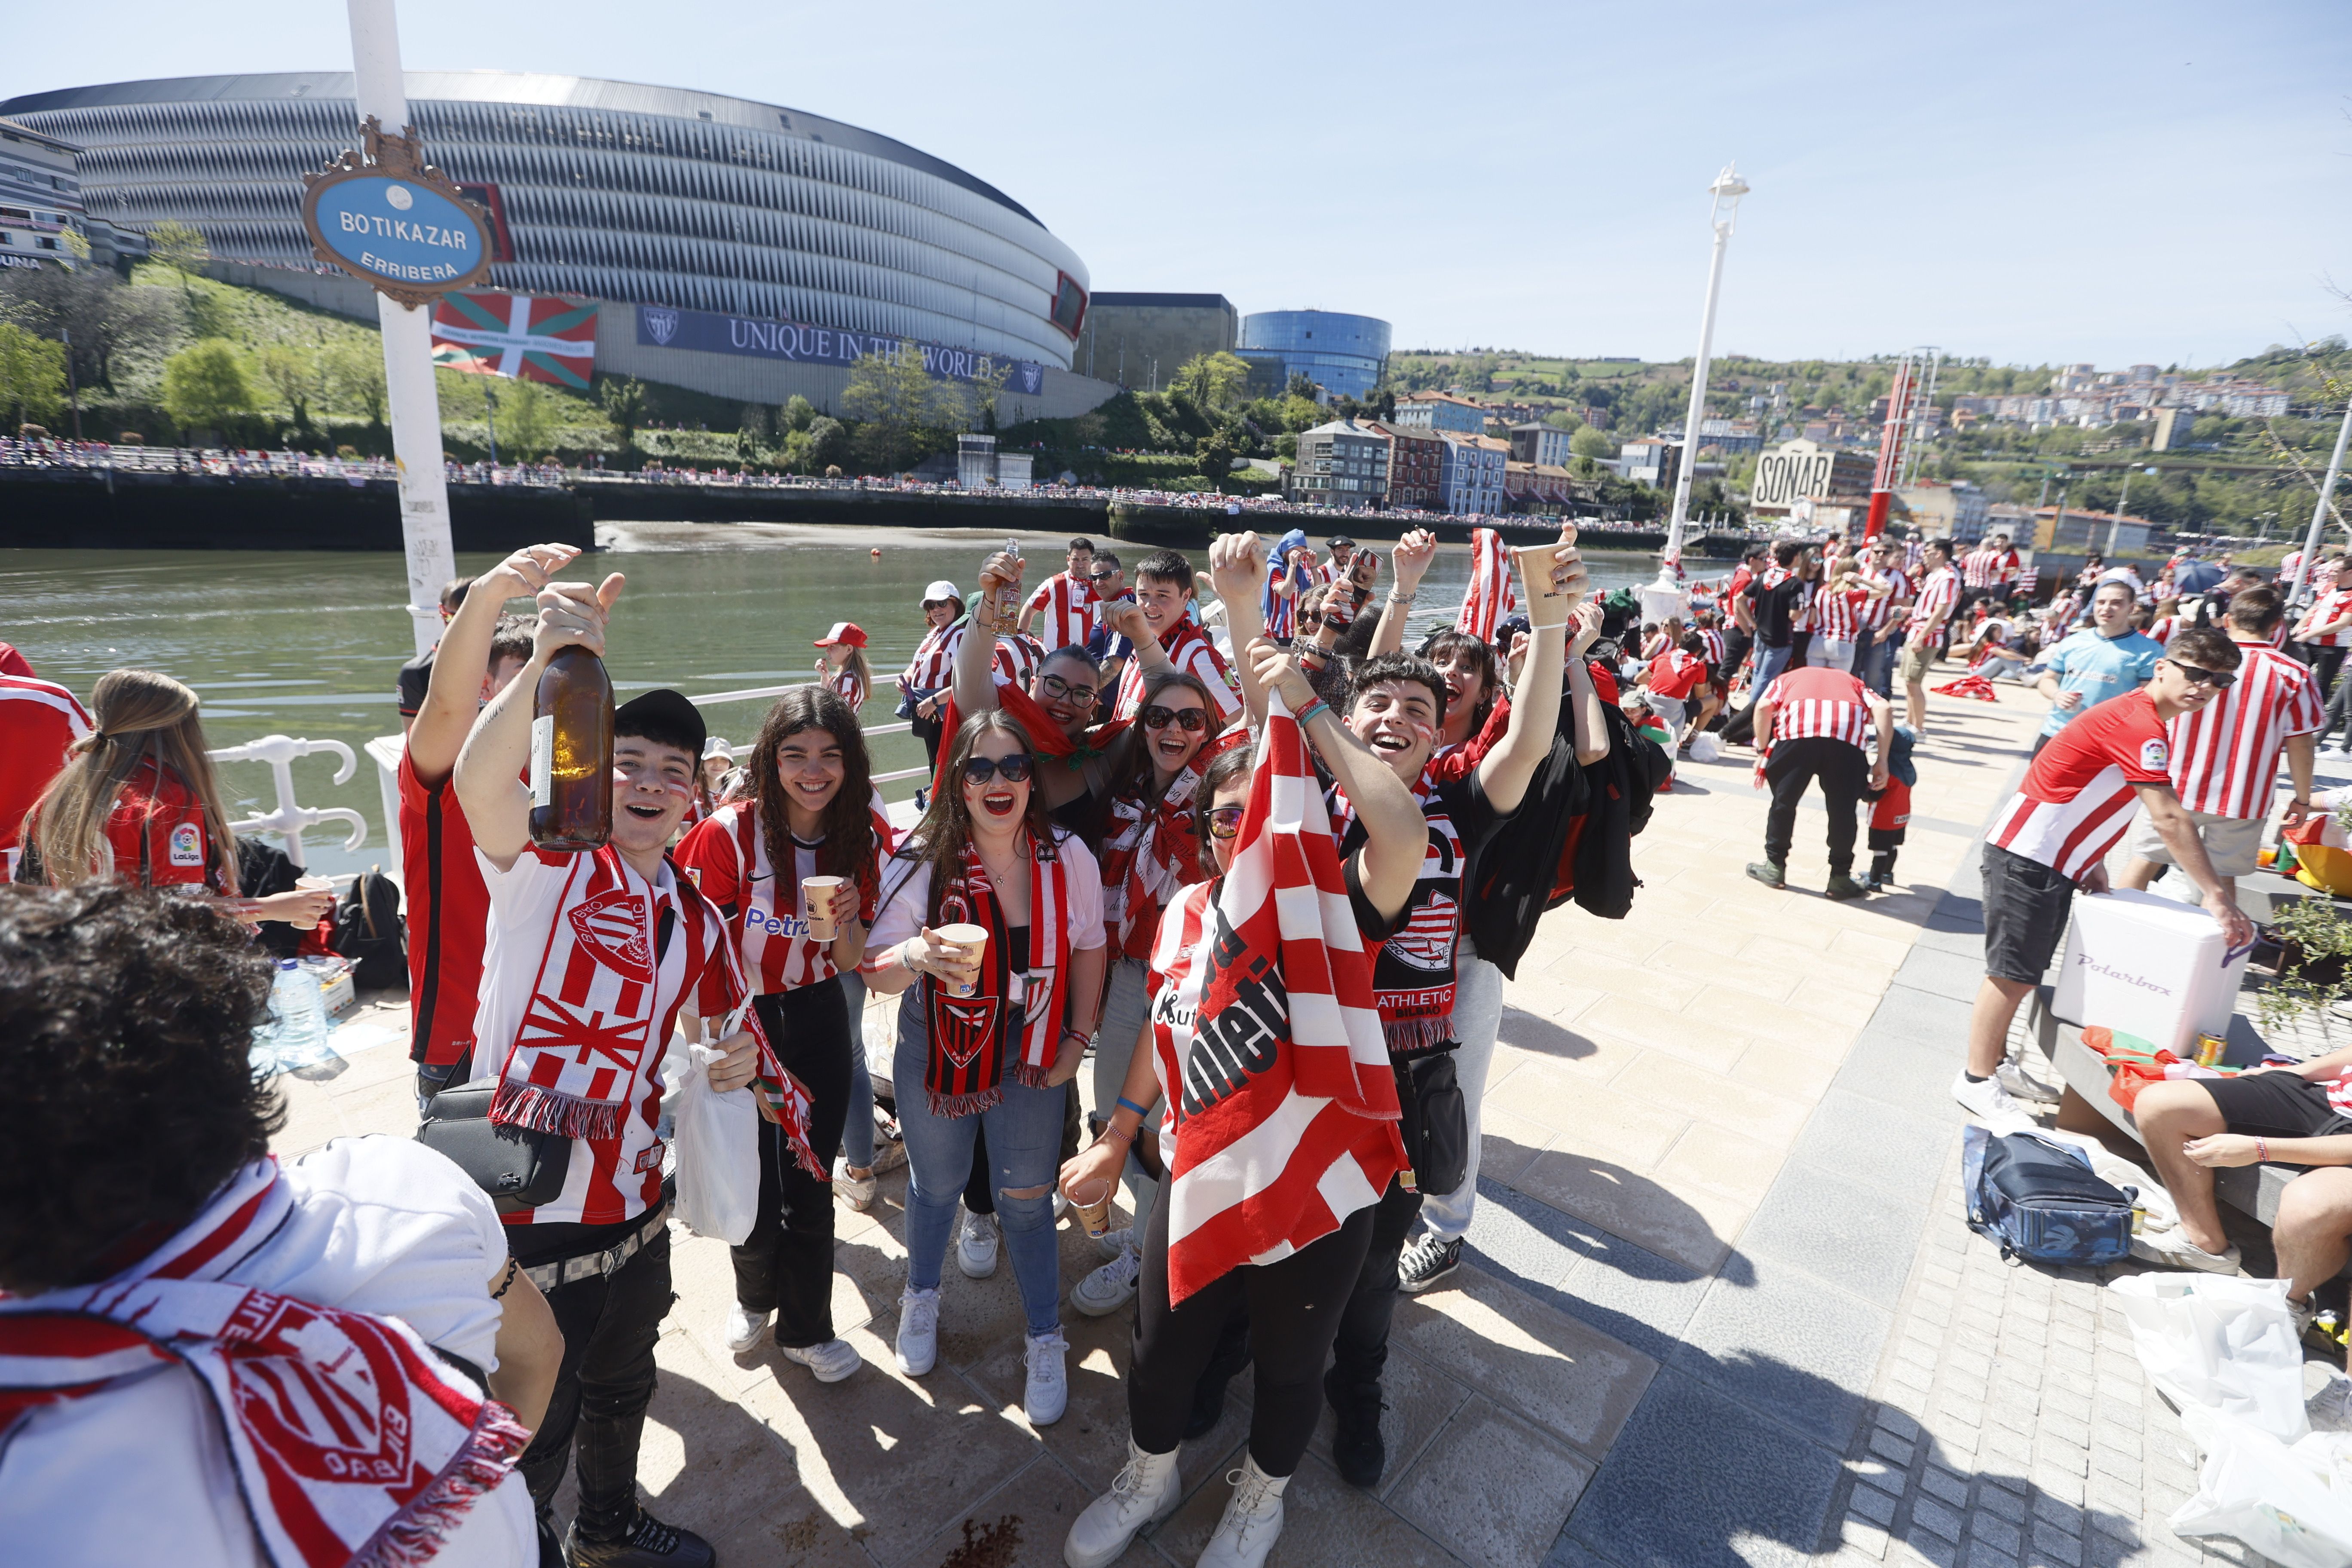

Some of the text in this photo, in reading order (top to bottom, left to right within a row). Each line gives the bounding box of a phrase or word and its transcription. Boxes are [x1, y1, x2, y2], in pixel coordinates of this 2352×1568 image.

[340, 211, 467, 250] BOTIKAZAR
[0, 254, 42, 270] UNA
[360, 251, 458, 280] ERRIBERA
[730, 319, 831, 360] UNIQUE
[838, 333, 863, 360] IN
[920, 345, 992, 379] WORLD
[1757, 450, 1828, 503] SOÑAR
[2078, 953, 2171, 996] Polarbox
[1377, 989, 1452, 1008] ATHLETIC
[1395, 1006, 1441, 1022] BILBAO
